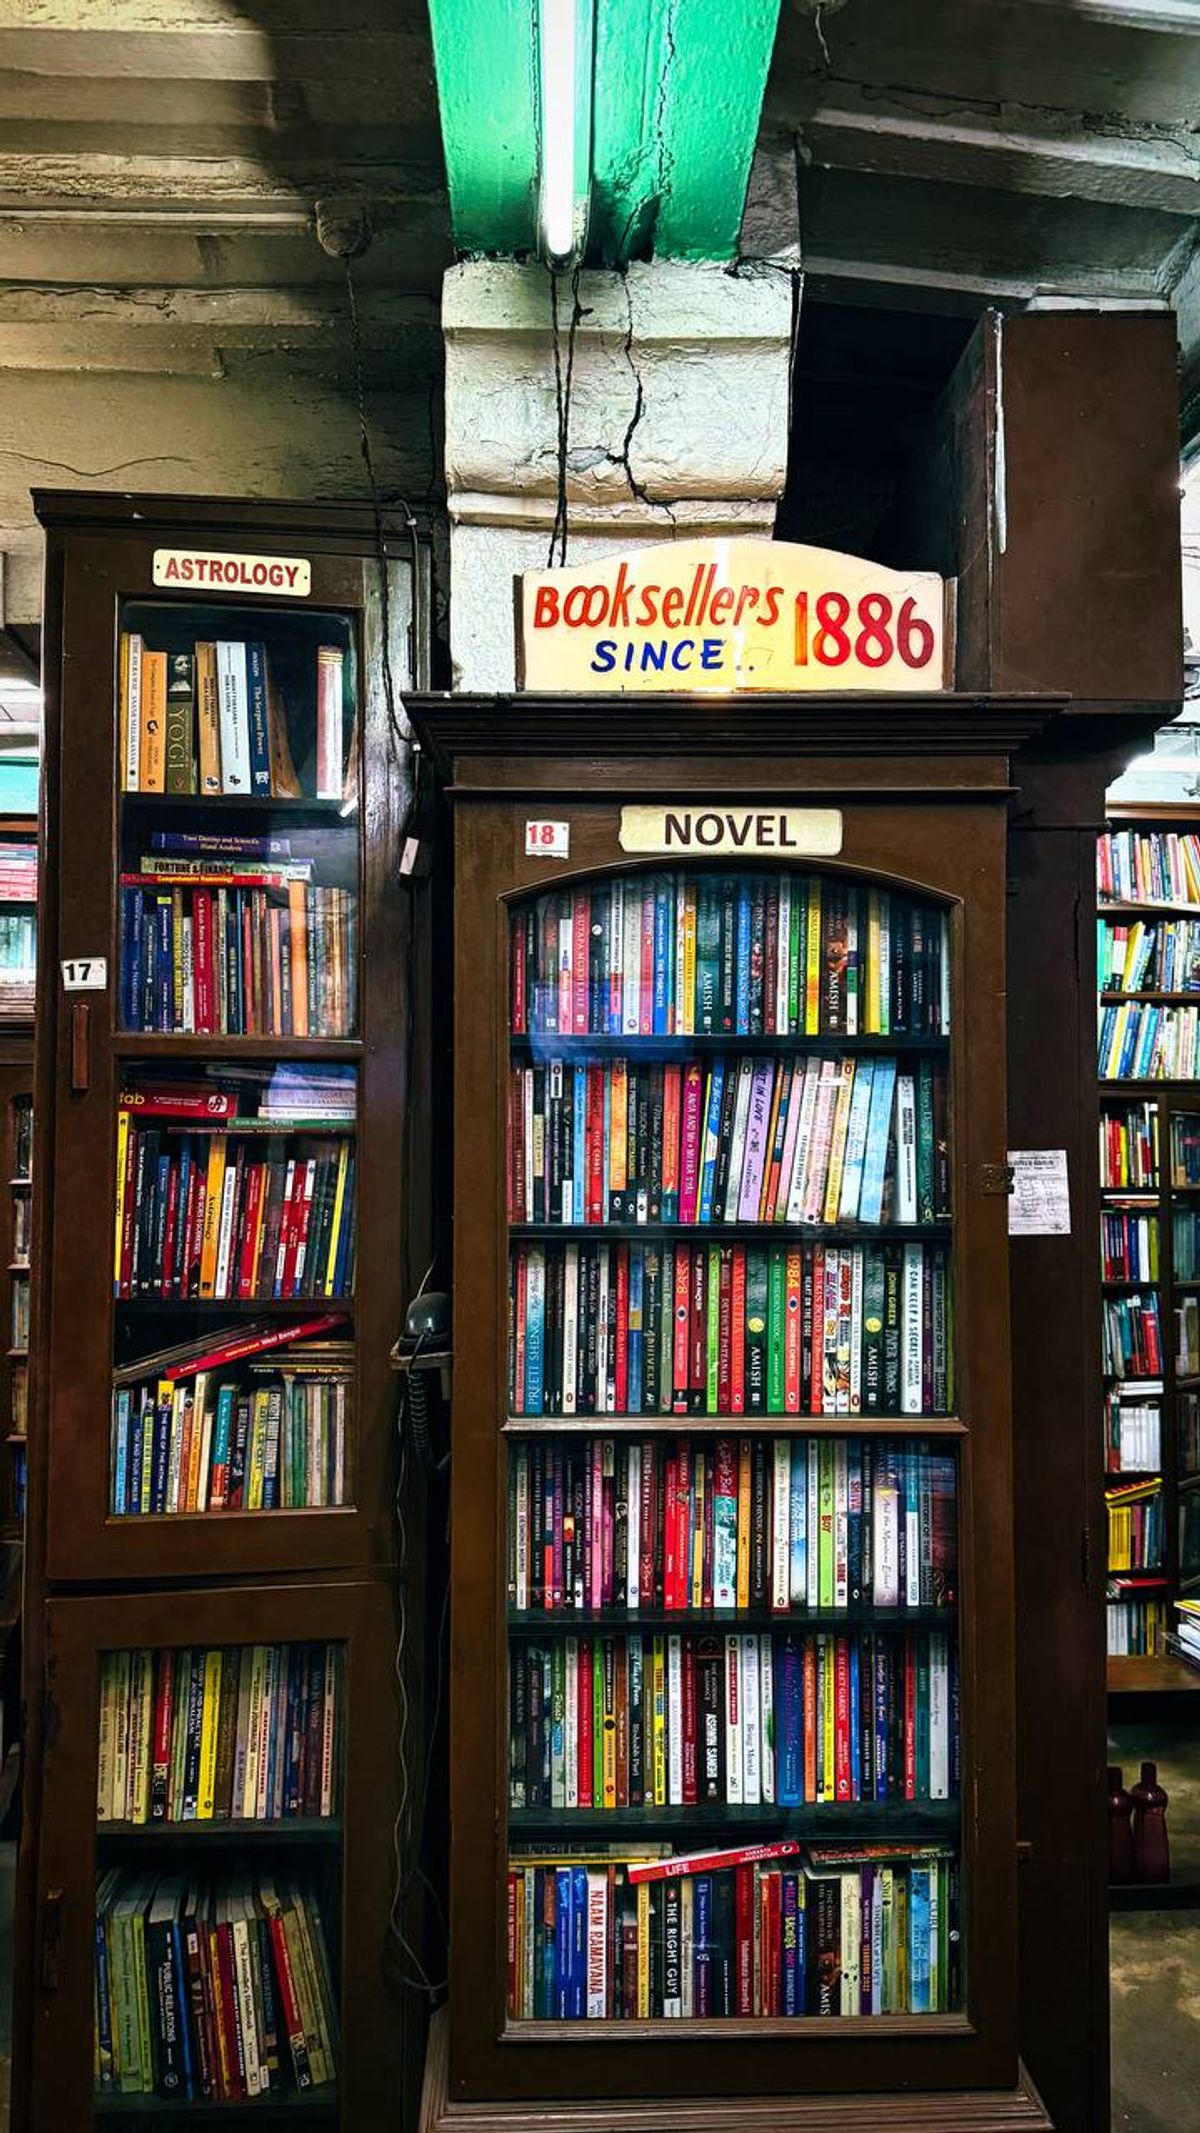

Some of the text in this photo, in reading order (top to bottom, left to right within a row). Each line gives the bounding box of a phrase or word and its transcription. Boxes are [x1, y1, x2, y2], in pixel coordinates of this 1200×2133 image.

[165, 557, 299, 587] ASTROLOGY
[533, 562, 935, 669] Booksellers 1886
[252, 703, 263, 730] Serpent
[168, 708, 185, 769] YOGI
[256, 731, 265, 755] Power
[528, 825, 554, 844] 18
[664, 813, 798, 846] NOVEL
[154, 861, 190, 873] FORTUNE
[64, 963, 92, 982] 17
[703, 971, 713, 1010] AMISH
[829, 971, 841, 1010] AMISH
[756, 1086, 767, 1095] IN
[688, 1114, 697, 1130] AND
[753, 1099, 765, 1122] LOVE
[787, 1254, 799, 1289] 1984
[909, 1271, 918, 1289] CAN
[813, 1304, 823, 1332] BOND
[909, 1292, 918, 1315] KEEP
[886, 1272, 898, 1393] JOHN GREEN PAPER TOWNS
[908, 1326, 918, 1358] SECRET
[751, 1347, 761, 1387] AMISH
[867, 1346, 878, 1387] AMISH
[528, 1365, 541, 1405] PREETI
[822, 1515, 832, 1533] BOY
[838, 1657, 846, 1687] SECRET
[838, 1688, 846, 1721] GARDEN
[705, 1713, 718, 1778] ASHWIN SANGHI
[746, 1723, 755, 1745] Being
[746, 1749, 755, 1776] Mortal
[665, 1863, 690, 1876] LIFE
[590, 1890, 604, 1995] NAAM RAMAYANA
[667, 1903, 677, 1993] THE RIGHT GUY
[163, 1962, 176, 2042] PUBLIC RELATIONS
